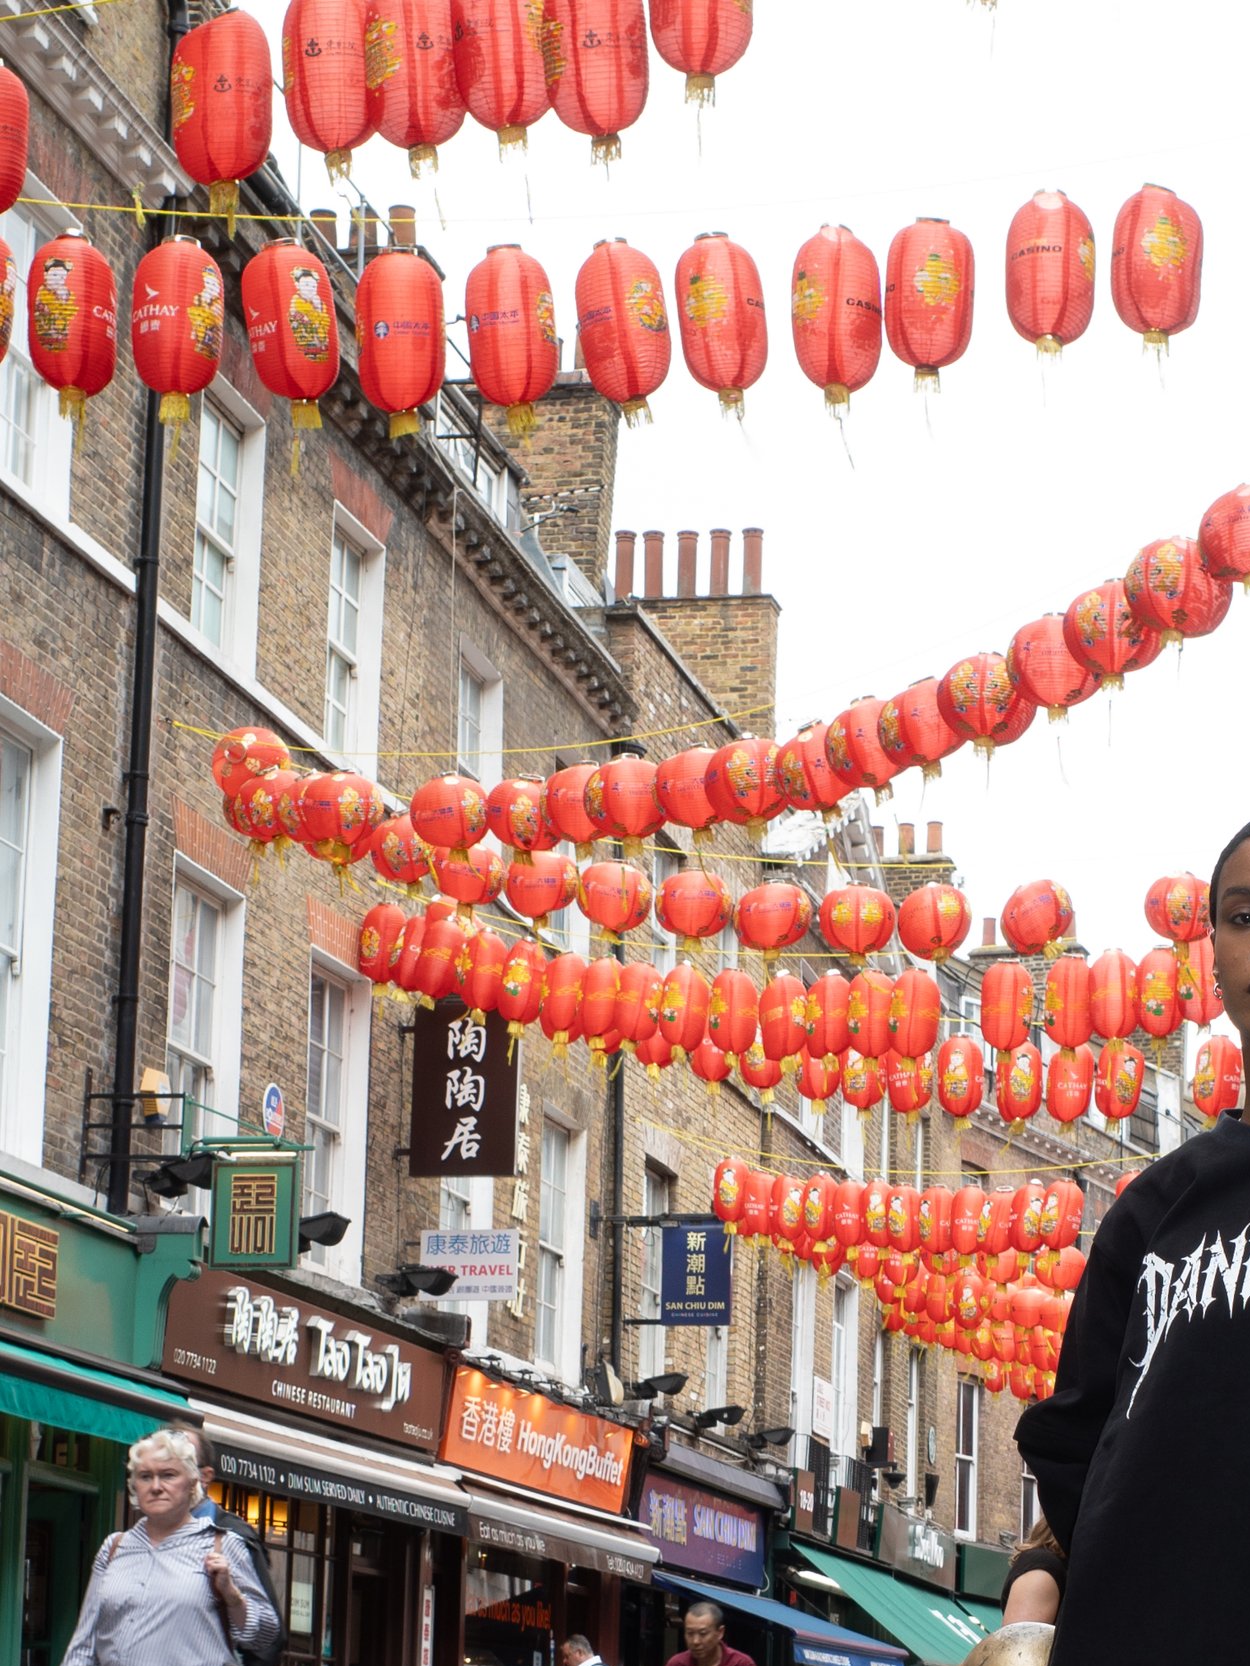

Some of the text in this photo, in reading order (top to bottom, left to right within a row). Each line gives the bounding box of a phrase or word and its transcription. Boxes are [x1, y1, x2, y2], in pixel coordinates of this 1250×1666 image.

[132, 304, 180, 323] CATHAY
[440, 1017, 487, 1161] 陶陶居
[426, 1234, 512, 1256] 康泰旅遊
[460, 1264, 513, 1276] TRAVEL
[685, 1231, 707, 1296] 新潮點
[665, 1301, 726, 1311] SAN CHIU DIM
[185, 1351, 202, 1369] 7734
[201, 1356, 217, 1375] 1122
[307, 1315, 413, 1413] Tao Tao Ju
[271, 1379, 357, 1420] CHINESE RESTAURANT
[461, 1395, 516, 1454] 香港樓
[220, 1453, 276, 1486] 020 7734 1122
[287, 1472, 366, 1506] DIM SUM SERVED DAILY
[376, 1493, 410, 1517] AUTHENTIC
[409, 1502, 434, 1522] CHINESE
[479, 1521, 491, 1540] Eat
[498, 1528, 516, 1546] much
[524, 1535, 536, 1551] you
